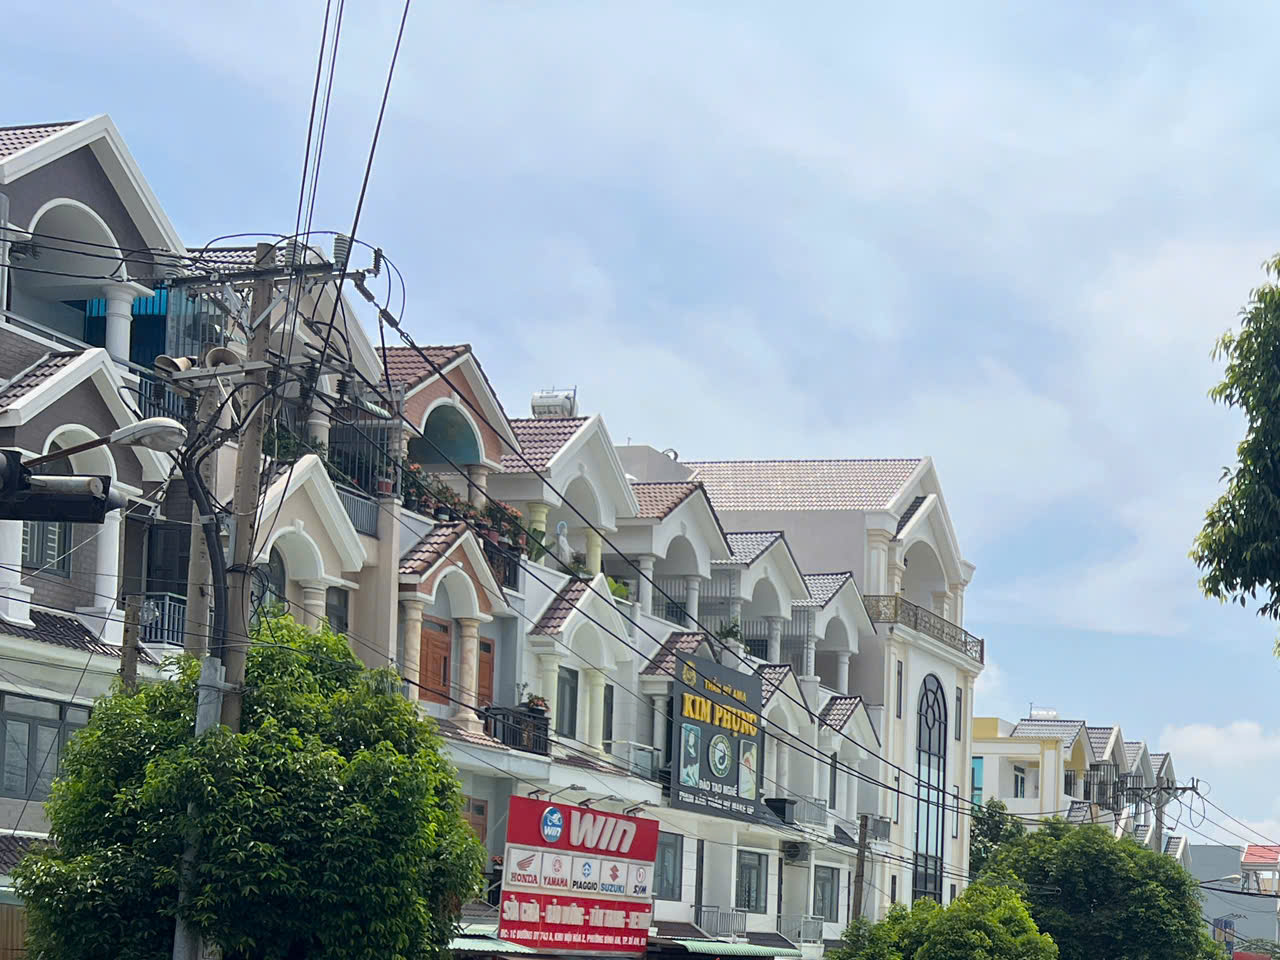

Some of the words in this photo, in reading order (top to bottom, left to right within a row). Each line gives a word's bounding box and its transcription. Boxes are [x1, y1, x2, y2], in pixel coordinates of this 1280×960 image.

[682, 692, 712, 723] KIM
[713, 704, 758, 736] PHỤNG
[511, 872, 538, 885] HONDA
[543, 876, 568, 888] YAMAHA
[572, 880, 598, 891] PIAGGIO
[601, 883, 624, 893] SUZUKI
[633, 885, 647, 895] SYM
